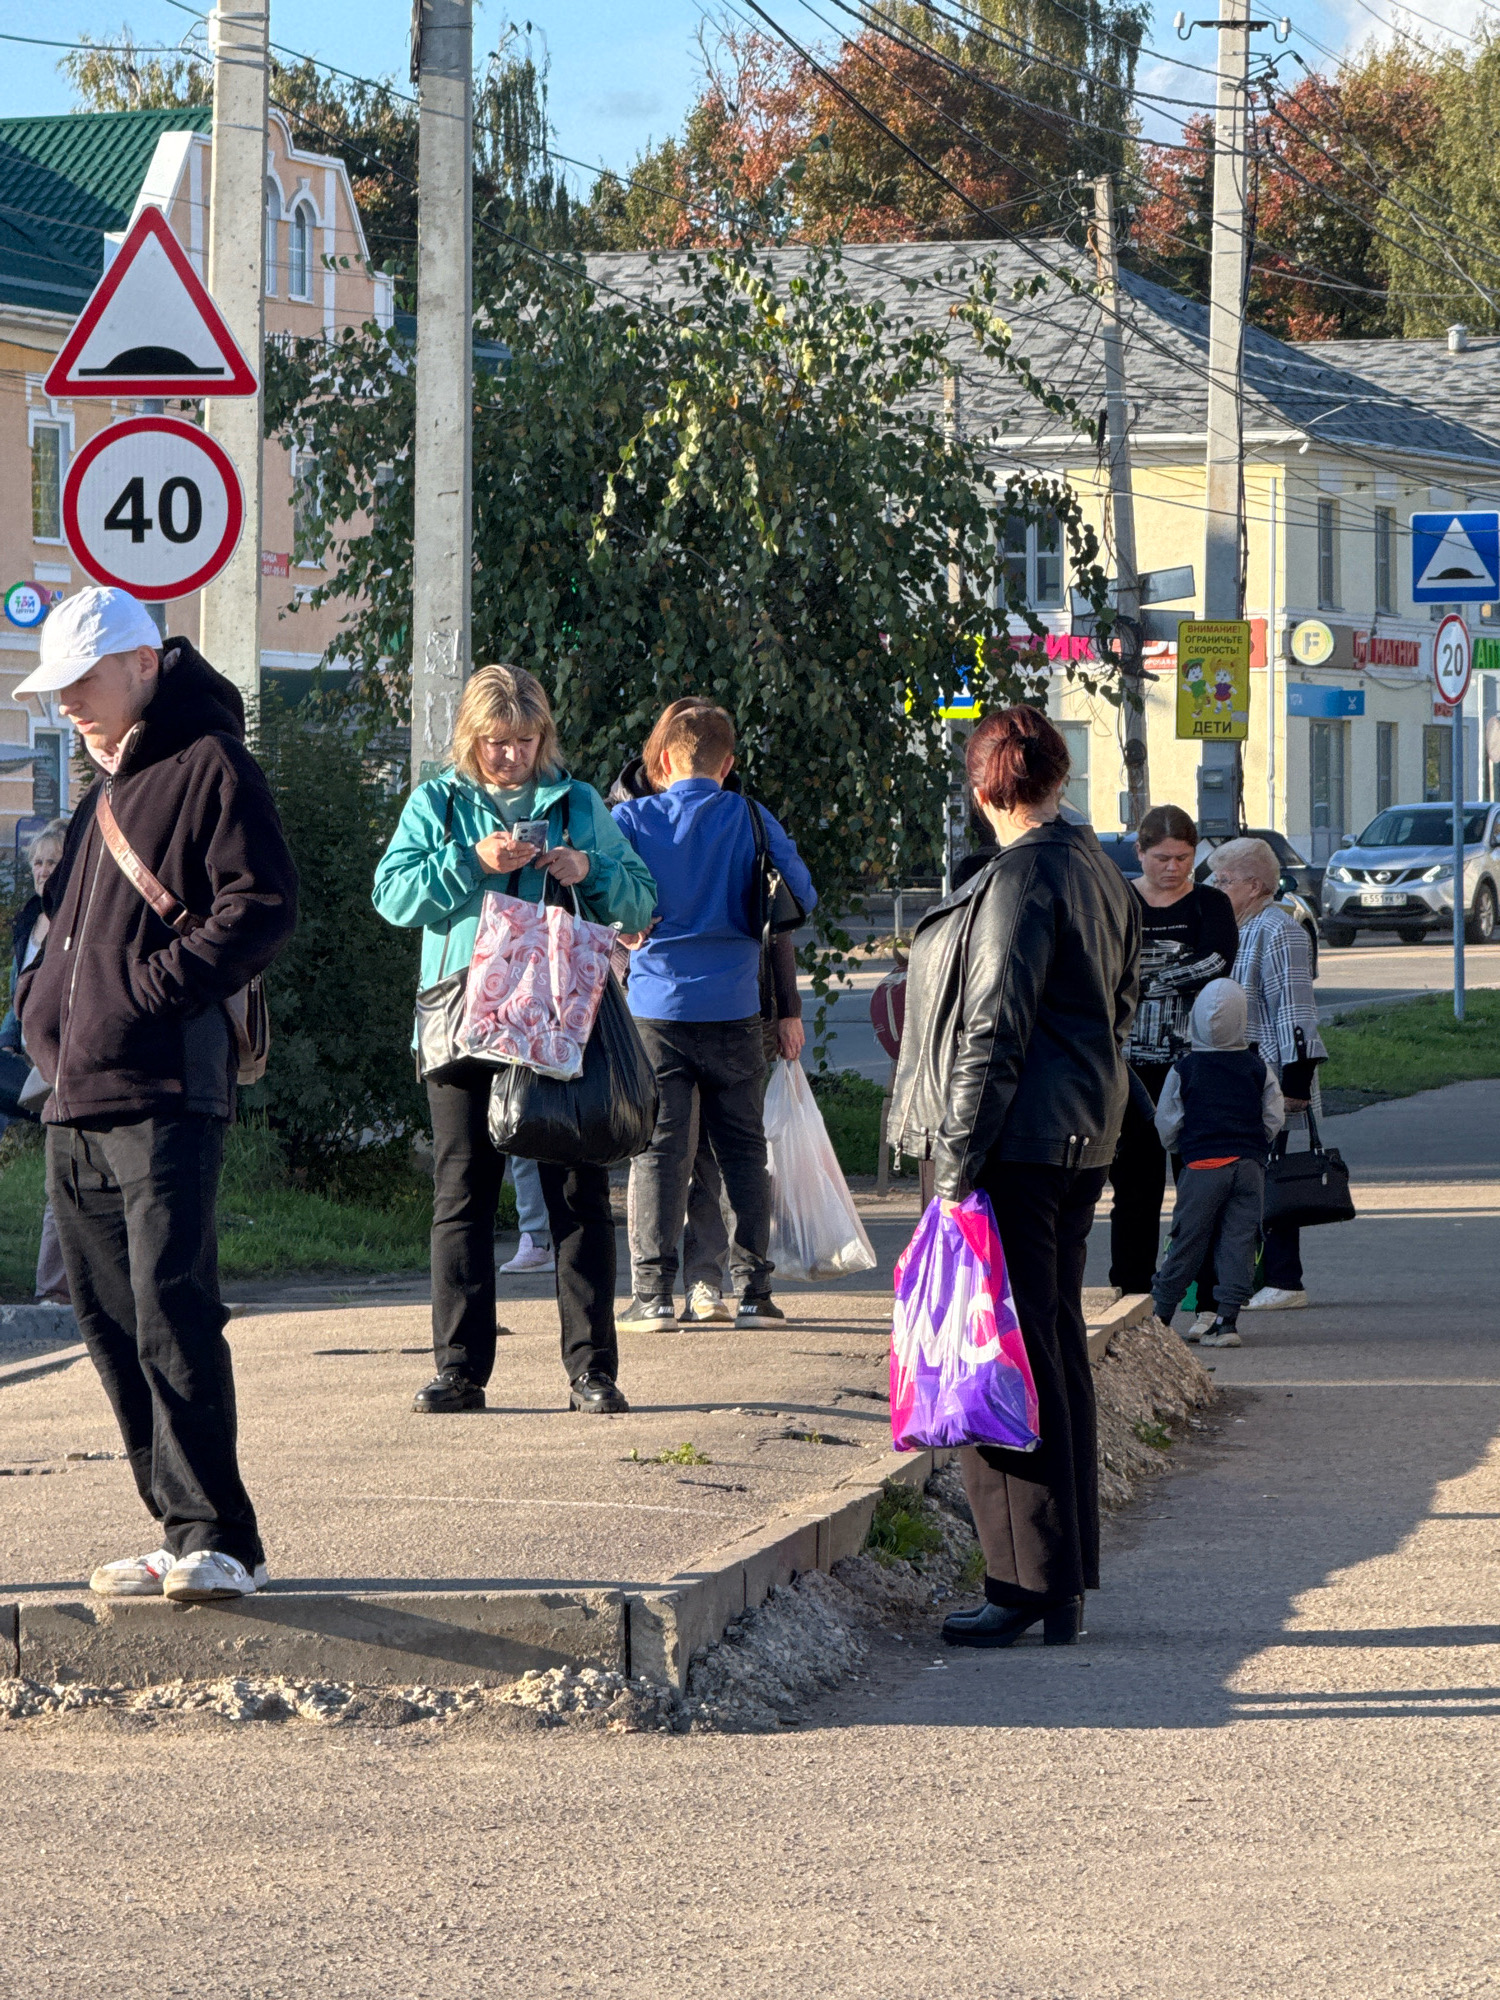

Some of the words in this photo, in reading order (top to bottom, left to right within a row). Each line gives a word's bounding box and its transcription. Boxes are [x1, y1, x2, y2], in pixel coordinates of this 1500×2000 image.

[103, 476, 203, 544] 40
[1187, 625, 1241, 633] ВНИМАНИЕ!
[1185, 636, 1243, 644] ОГРАНИЧЬТЕ
[1187, 646, 1240, 654] СКОРОСТЬ!
[1372, 638, 1420, 666] МАГНИТ
[1442, 643, 1464, 676] 20
[1192, 721, 1232, 735] ДЕТИ
[510, 966, 566, 990] ROSS
